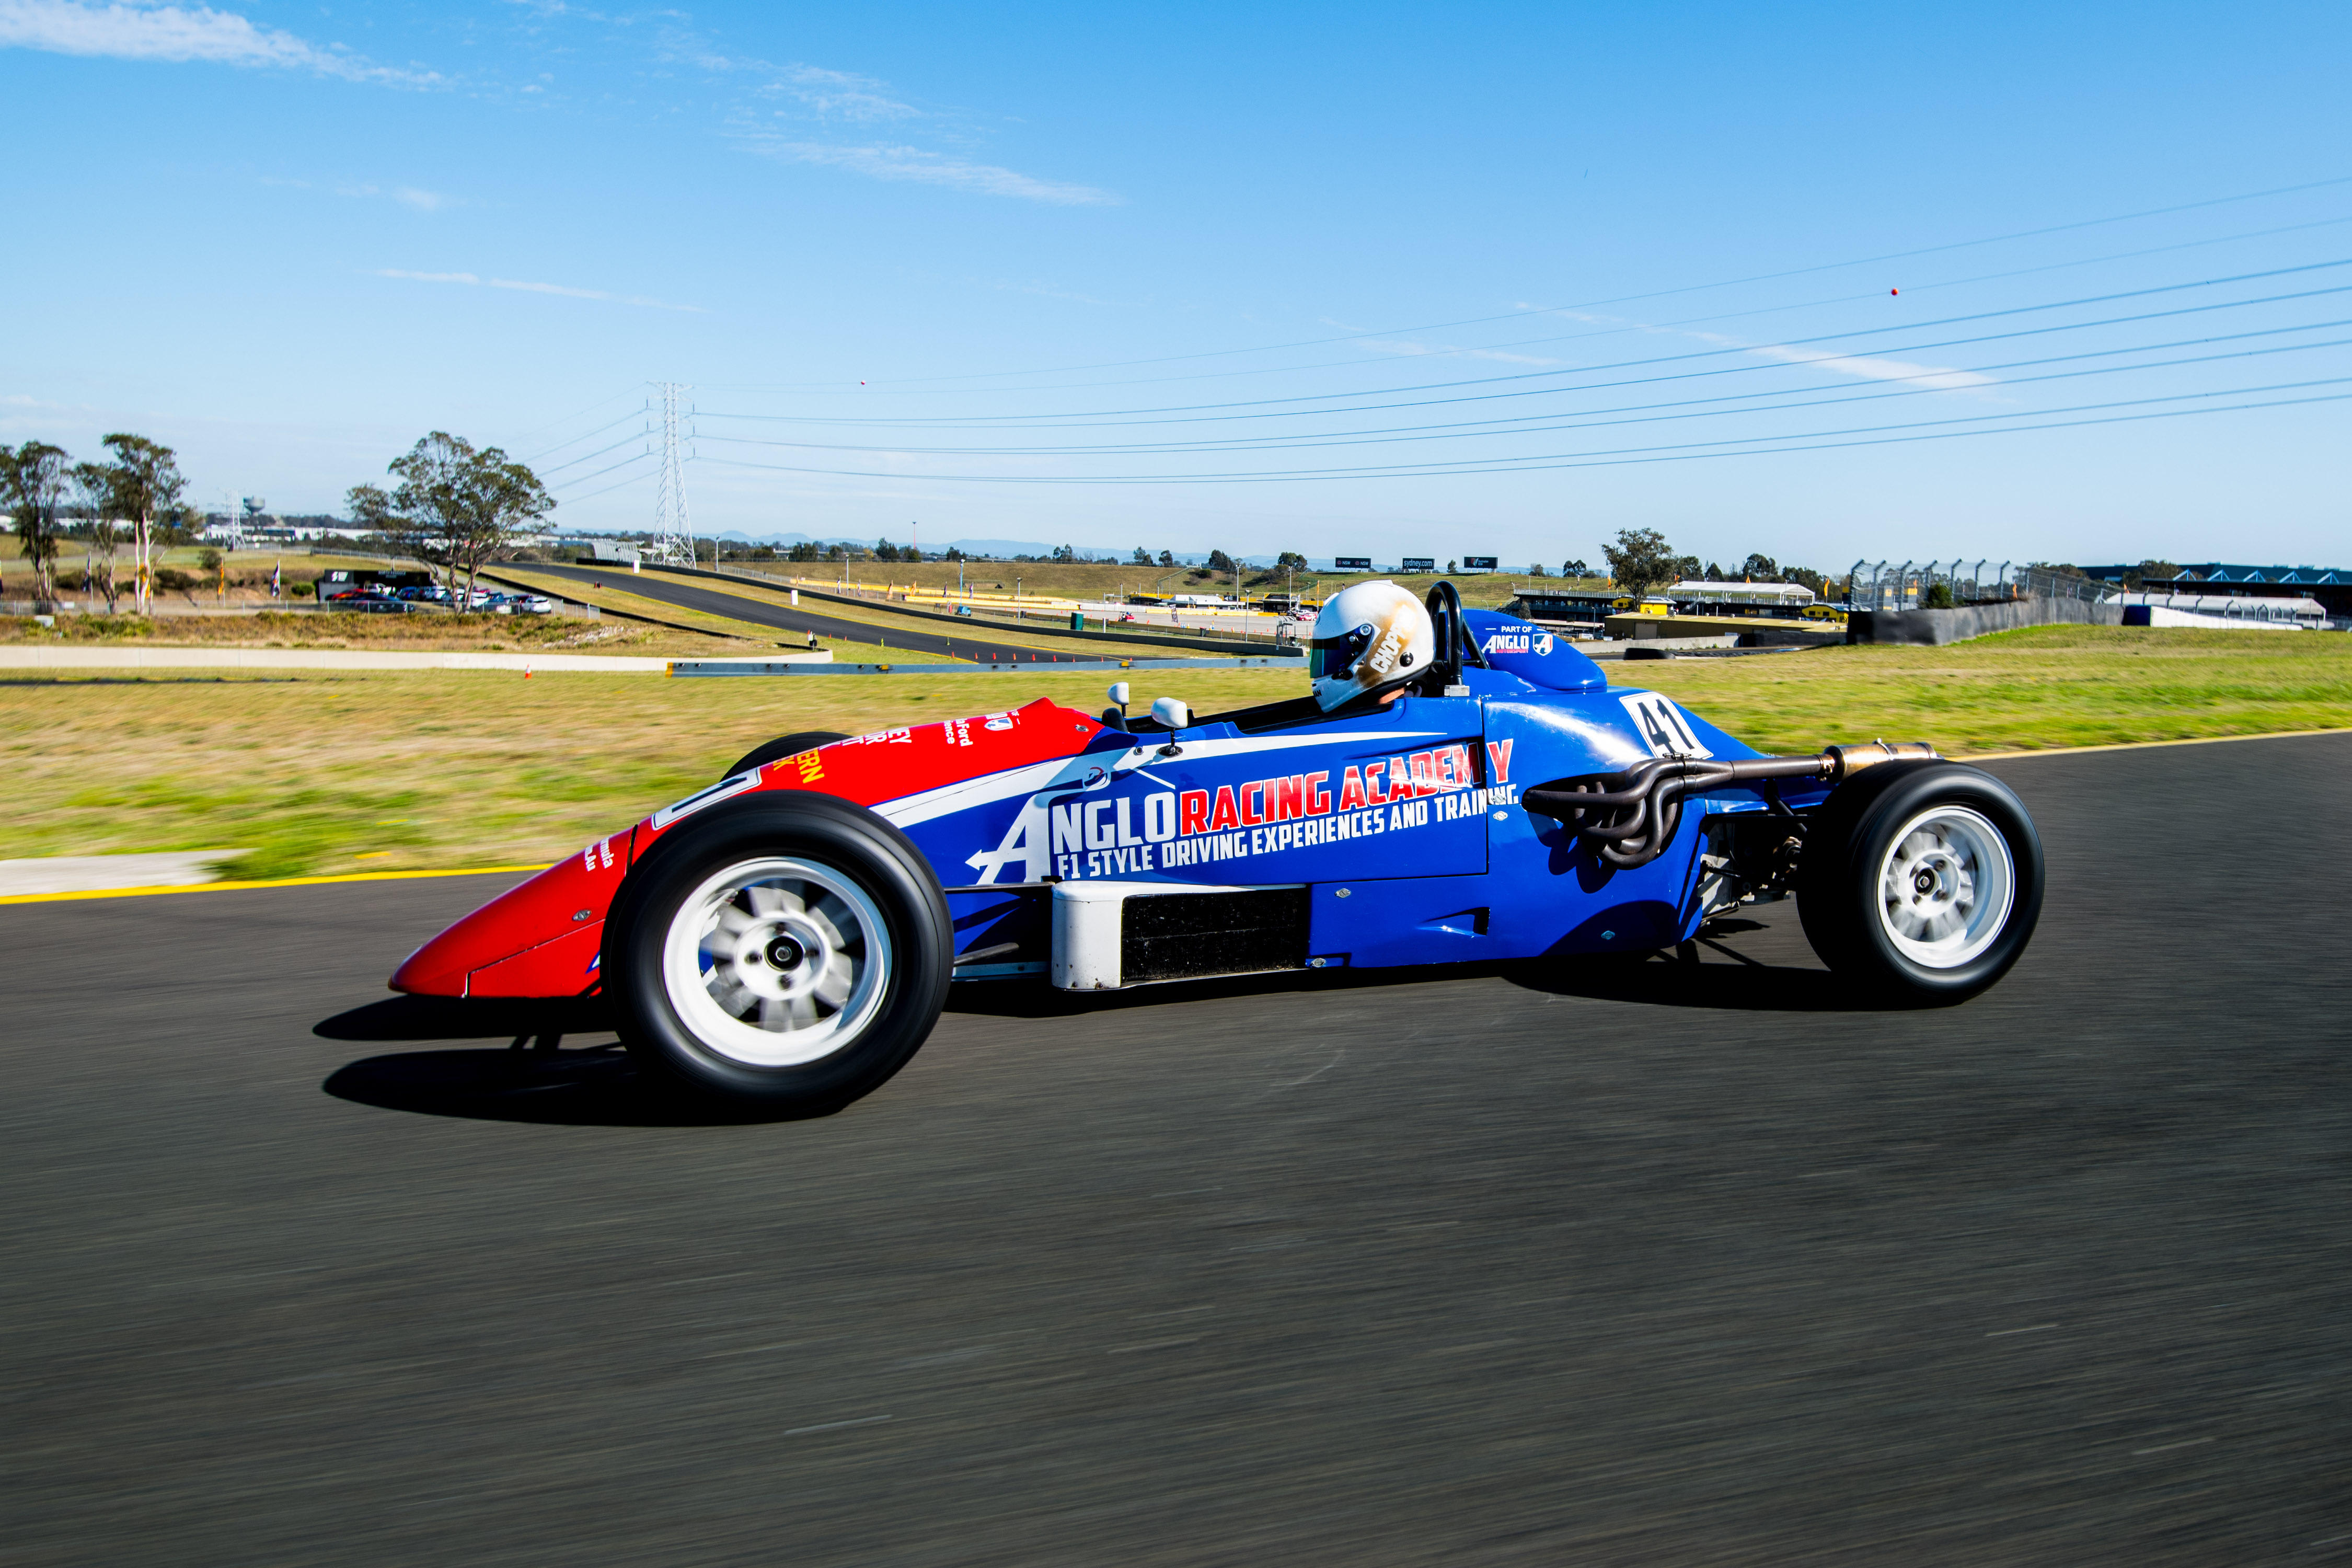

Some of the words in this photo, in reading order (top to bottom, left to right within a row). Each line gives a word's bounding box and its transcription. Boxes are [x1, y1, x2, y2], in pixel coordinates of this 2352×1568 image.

[1404, 559, 1432, 568] sydney.com
[1370, 605, 1415, 673] CHOPP
[1481, 635, 1529, 653] ANGLO
[1637, 699, 1695, 754] 41
[965, 791, 1175, 885] ANGLO
[1180, 770, 1331, 837] RACING
[1338, 738, 1514, 812] ACADEMY
[1058, 854, 1081, 879] F1
[1088, 845, 1154, 878] STYLE
[1162, 831, 1248, 868] DRIVING
[1252, 808, 1385, 855] EXPERIENCES
[1389, 800, 1428, 831] AND
[1434, 783, 1519, 822] TRAINING
